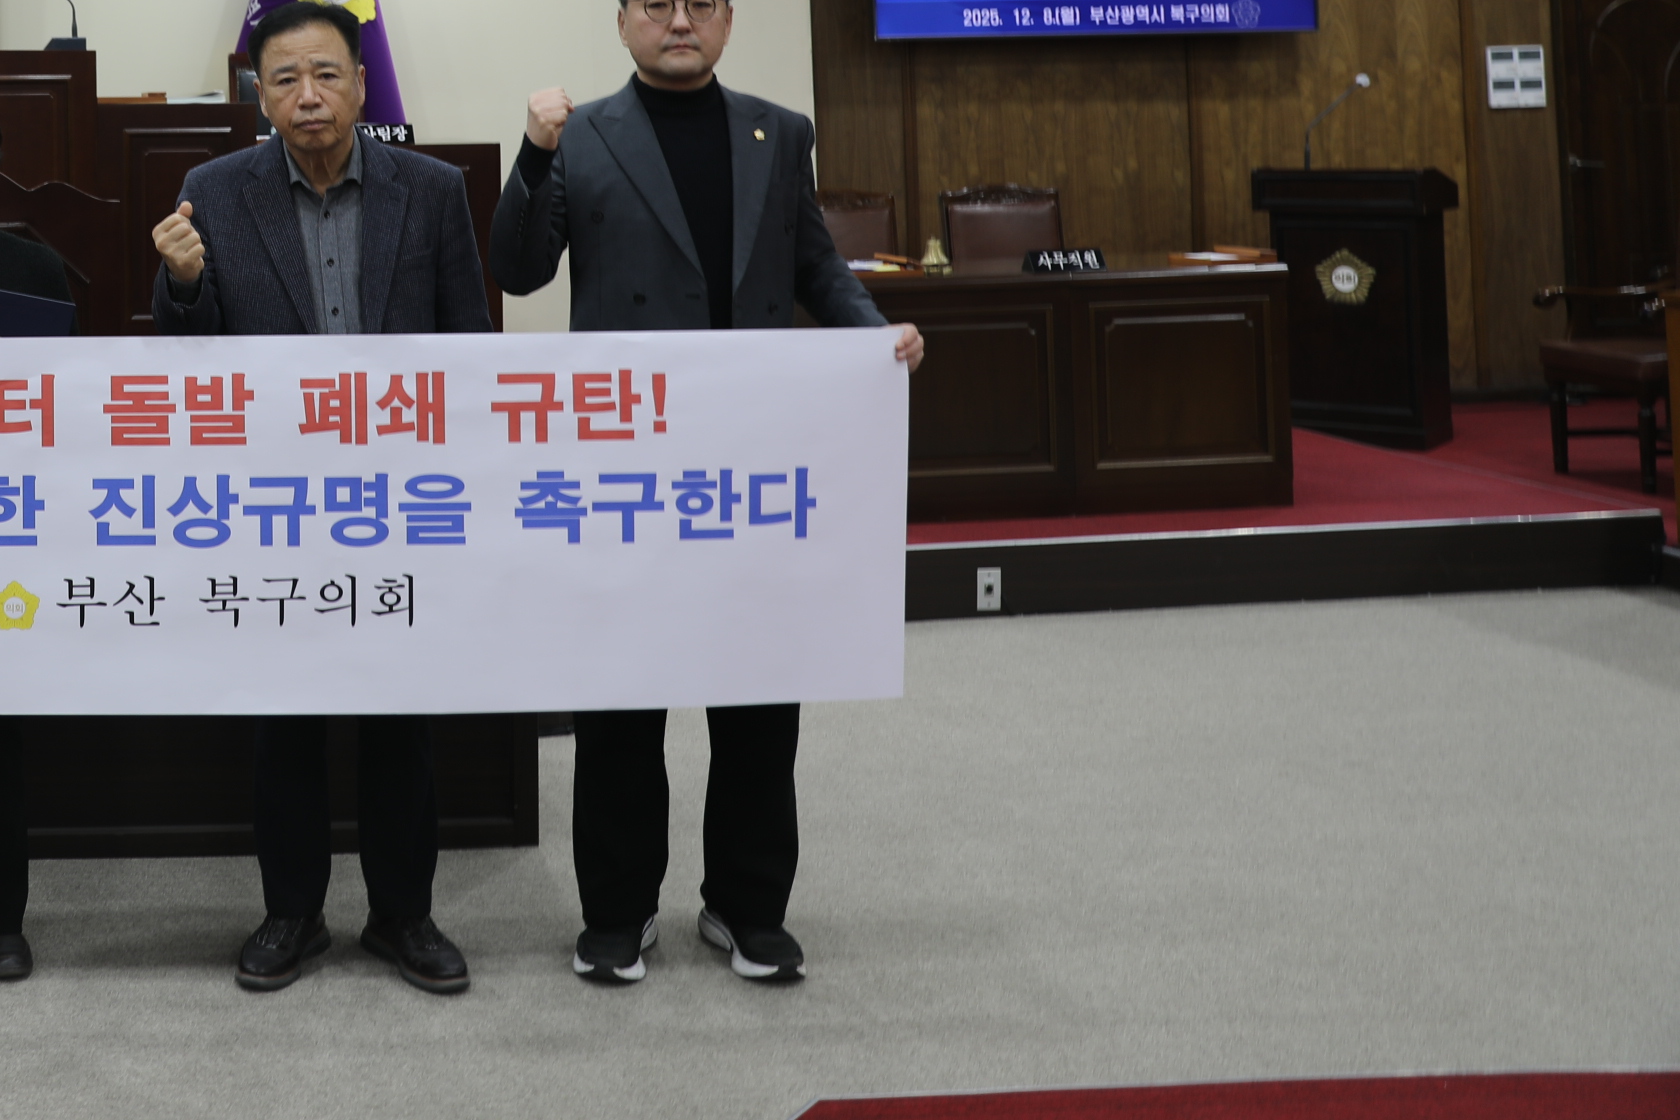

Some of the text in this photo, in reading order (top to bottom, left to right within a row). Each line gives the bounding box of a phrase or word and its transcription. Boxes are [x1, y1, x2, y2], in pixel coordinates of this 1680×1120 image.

[1013, 8, 1034, 26] 12.
[1090, 4, 1165, 25] 부산광역시
[1171, 3, 1230, 24] 북구의회
[1038, 249, 1100, 271] 사무직원
[103, 373, 255, 447] 돌발
[299, 371, 446, 446] 폐쇄
[491, 369, 668, 444] 규탄!
[89, 472, 472, 549] 진상규명을
[514, 466, 817, 544] 촉구한다
[56, 575, 166, 629] 부산
[199, 574, 414, 628] 북구의회
